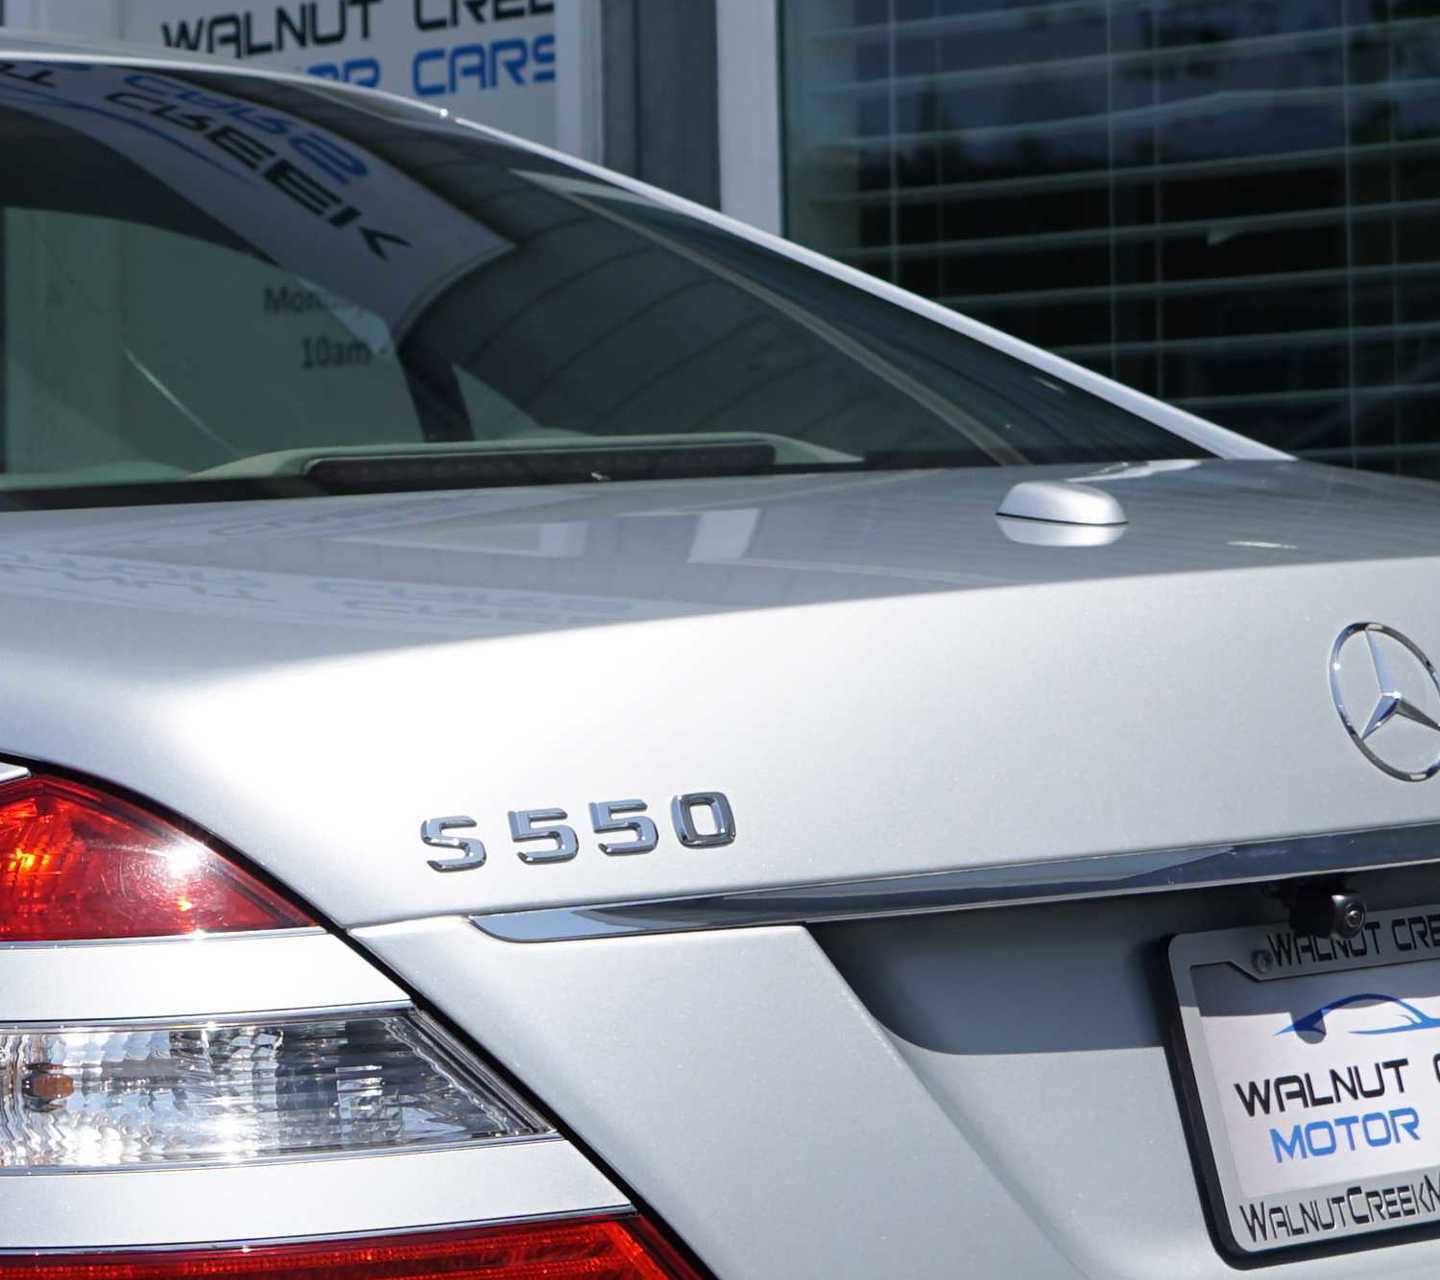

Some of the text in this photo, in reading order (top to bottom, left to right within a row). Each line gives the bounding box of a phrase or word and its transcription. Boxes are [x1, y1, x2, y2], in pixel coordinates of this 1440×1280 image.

[411, 34, 555, 97] CARS
[420, 791, 737, 873] S 550
[1233, 1057, 1409, 1118] WALNUT
[1269, 1107, 1420, 1164] MOTOR
